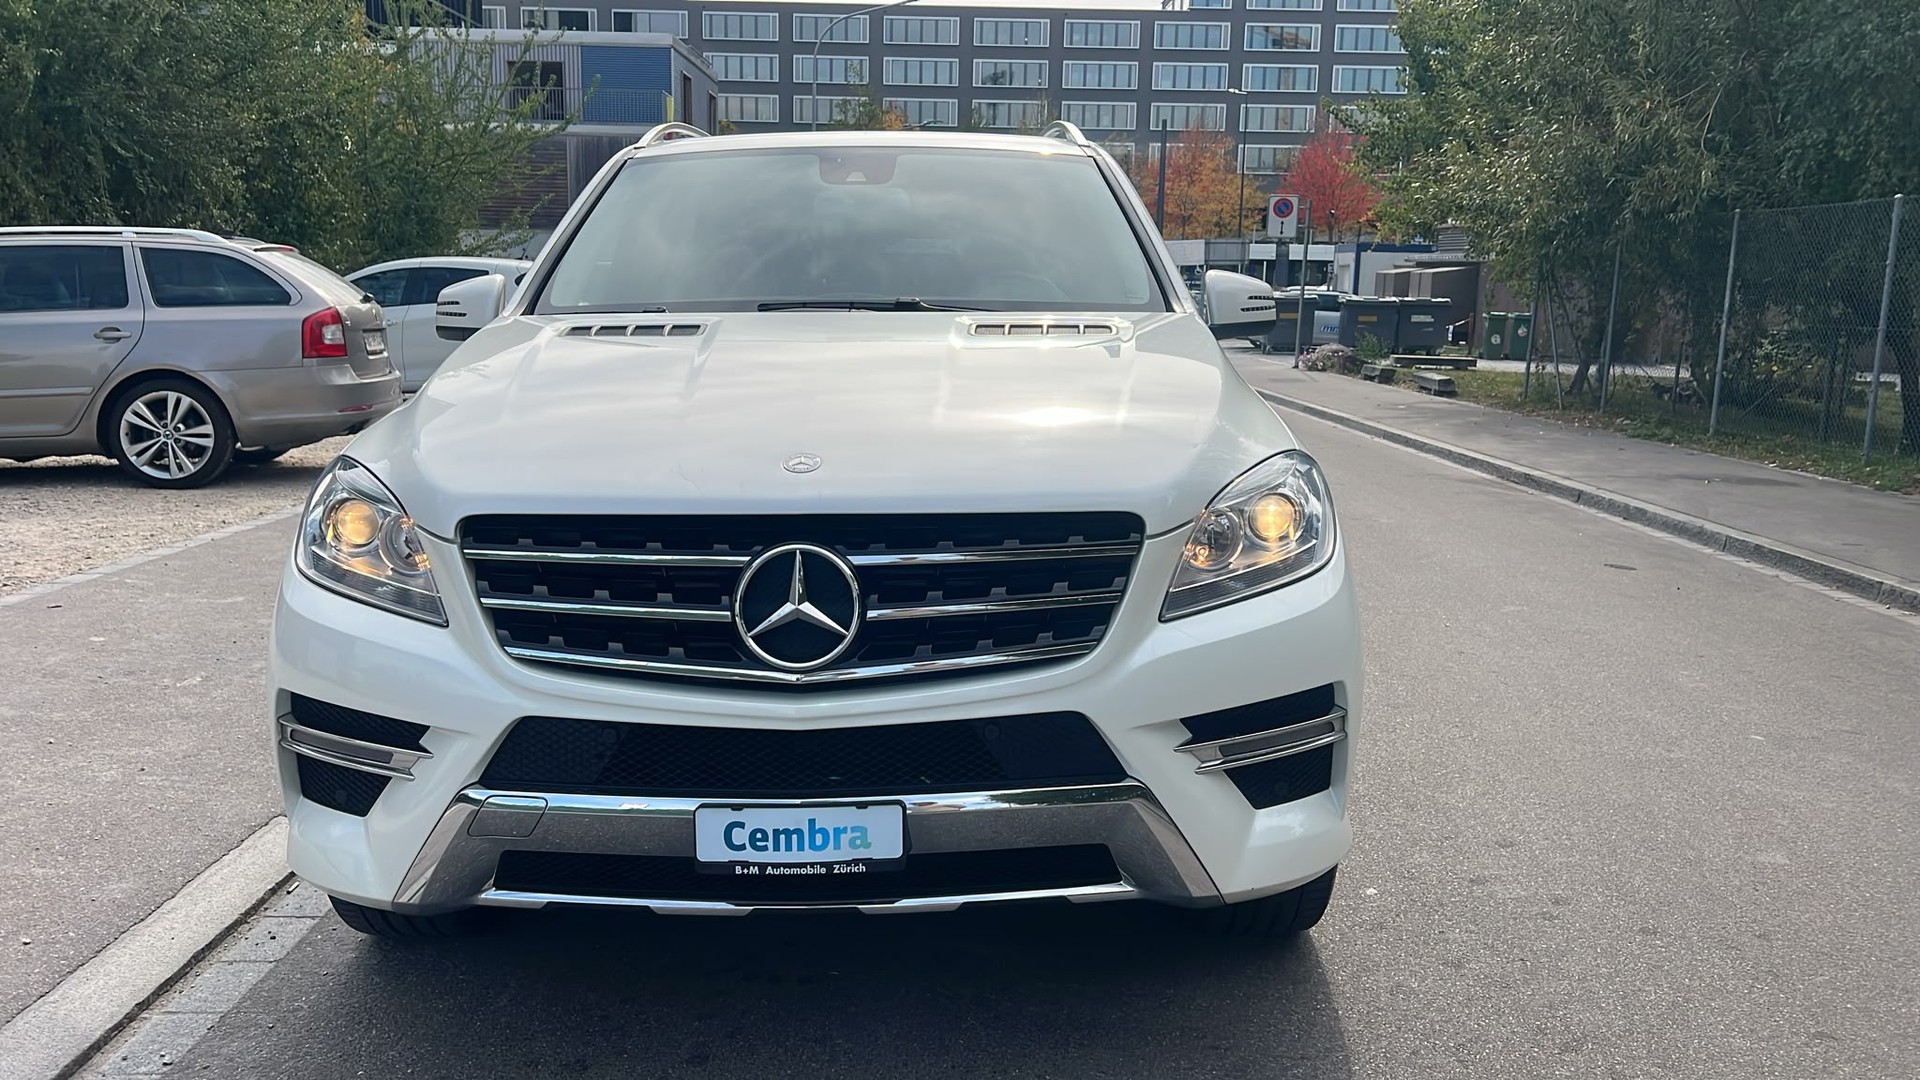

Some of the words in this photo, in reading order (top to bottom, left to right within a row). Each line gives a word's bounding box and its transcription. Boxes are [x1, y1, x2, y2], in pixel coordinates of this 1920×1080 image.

[723, 818, 871, 852] Cembra
[735, 865, 759, 875] B+M
[765, 864, 827, 875] Automobile
[832, 863, 866, 874] Zürich
